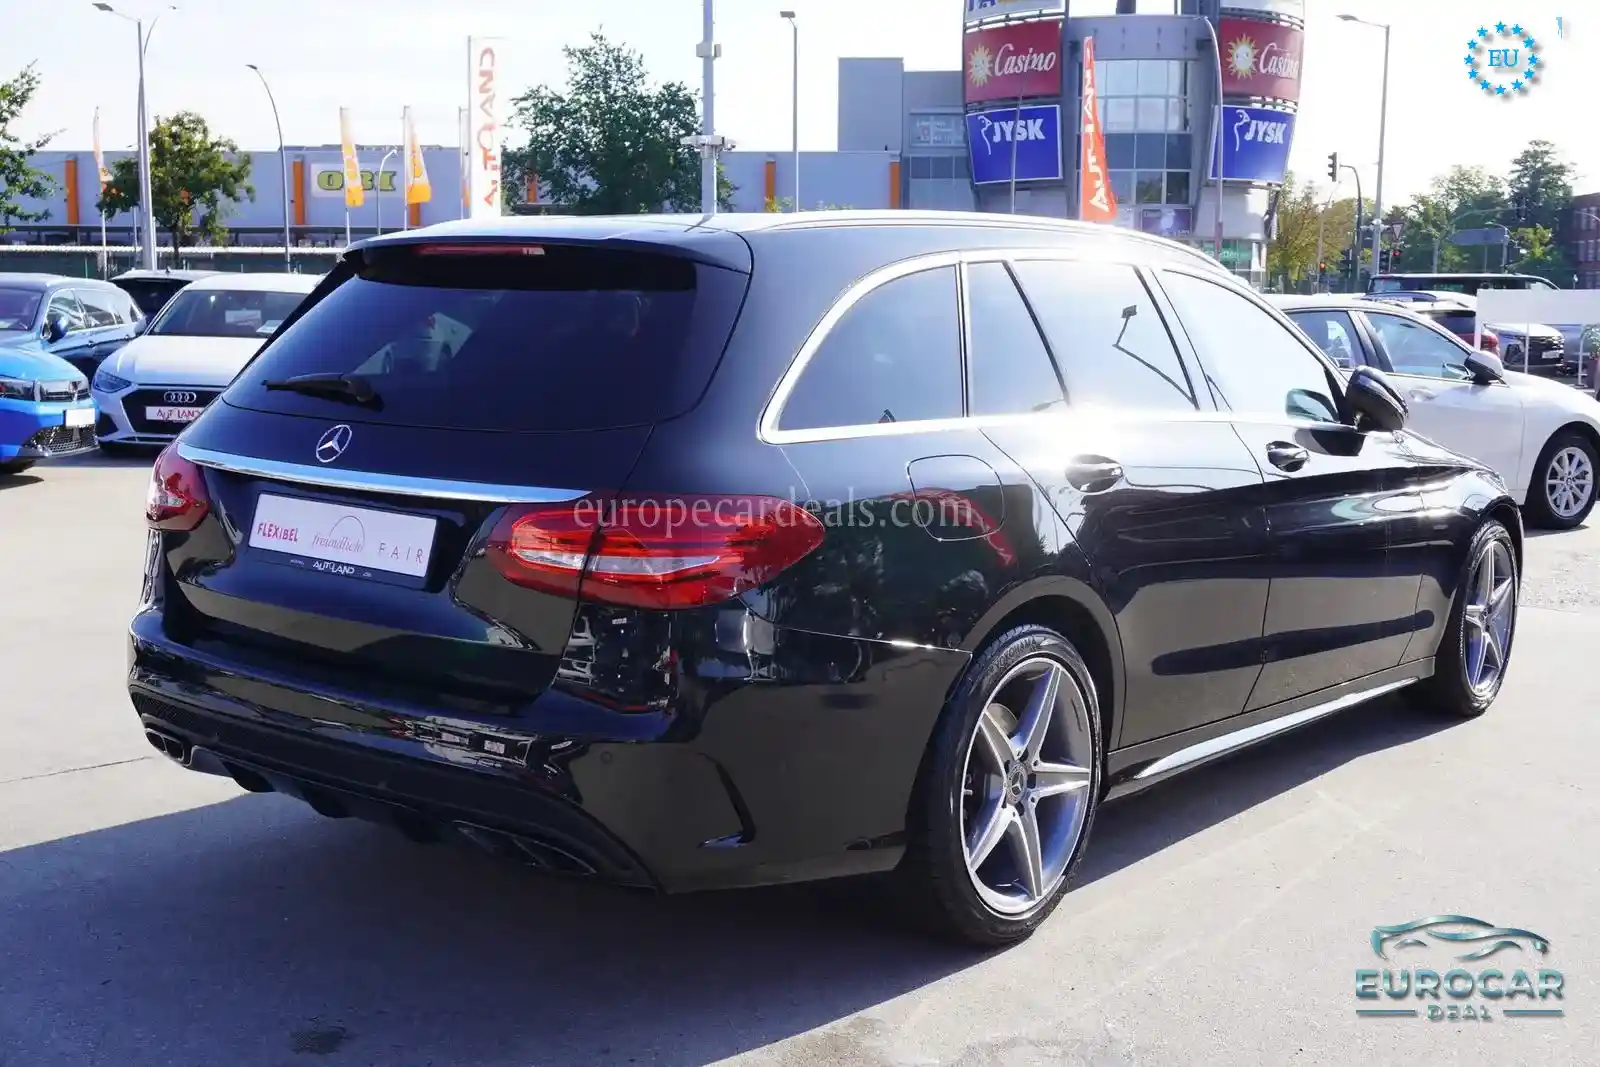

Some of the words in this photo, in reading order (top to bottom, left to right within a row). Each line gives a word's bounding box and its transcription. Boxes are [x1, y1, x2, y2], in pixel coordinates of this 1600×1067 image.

[994, 43, 1056, 76] Casino
[1260, 42, 1299, 78] Casin
[992, 118, 1045, 142] JYSK
[1244, 119, 1287, 144] JYSK
[257, 522, 299, 542] FLEXIBEL
